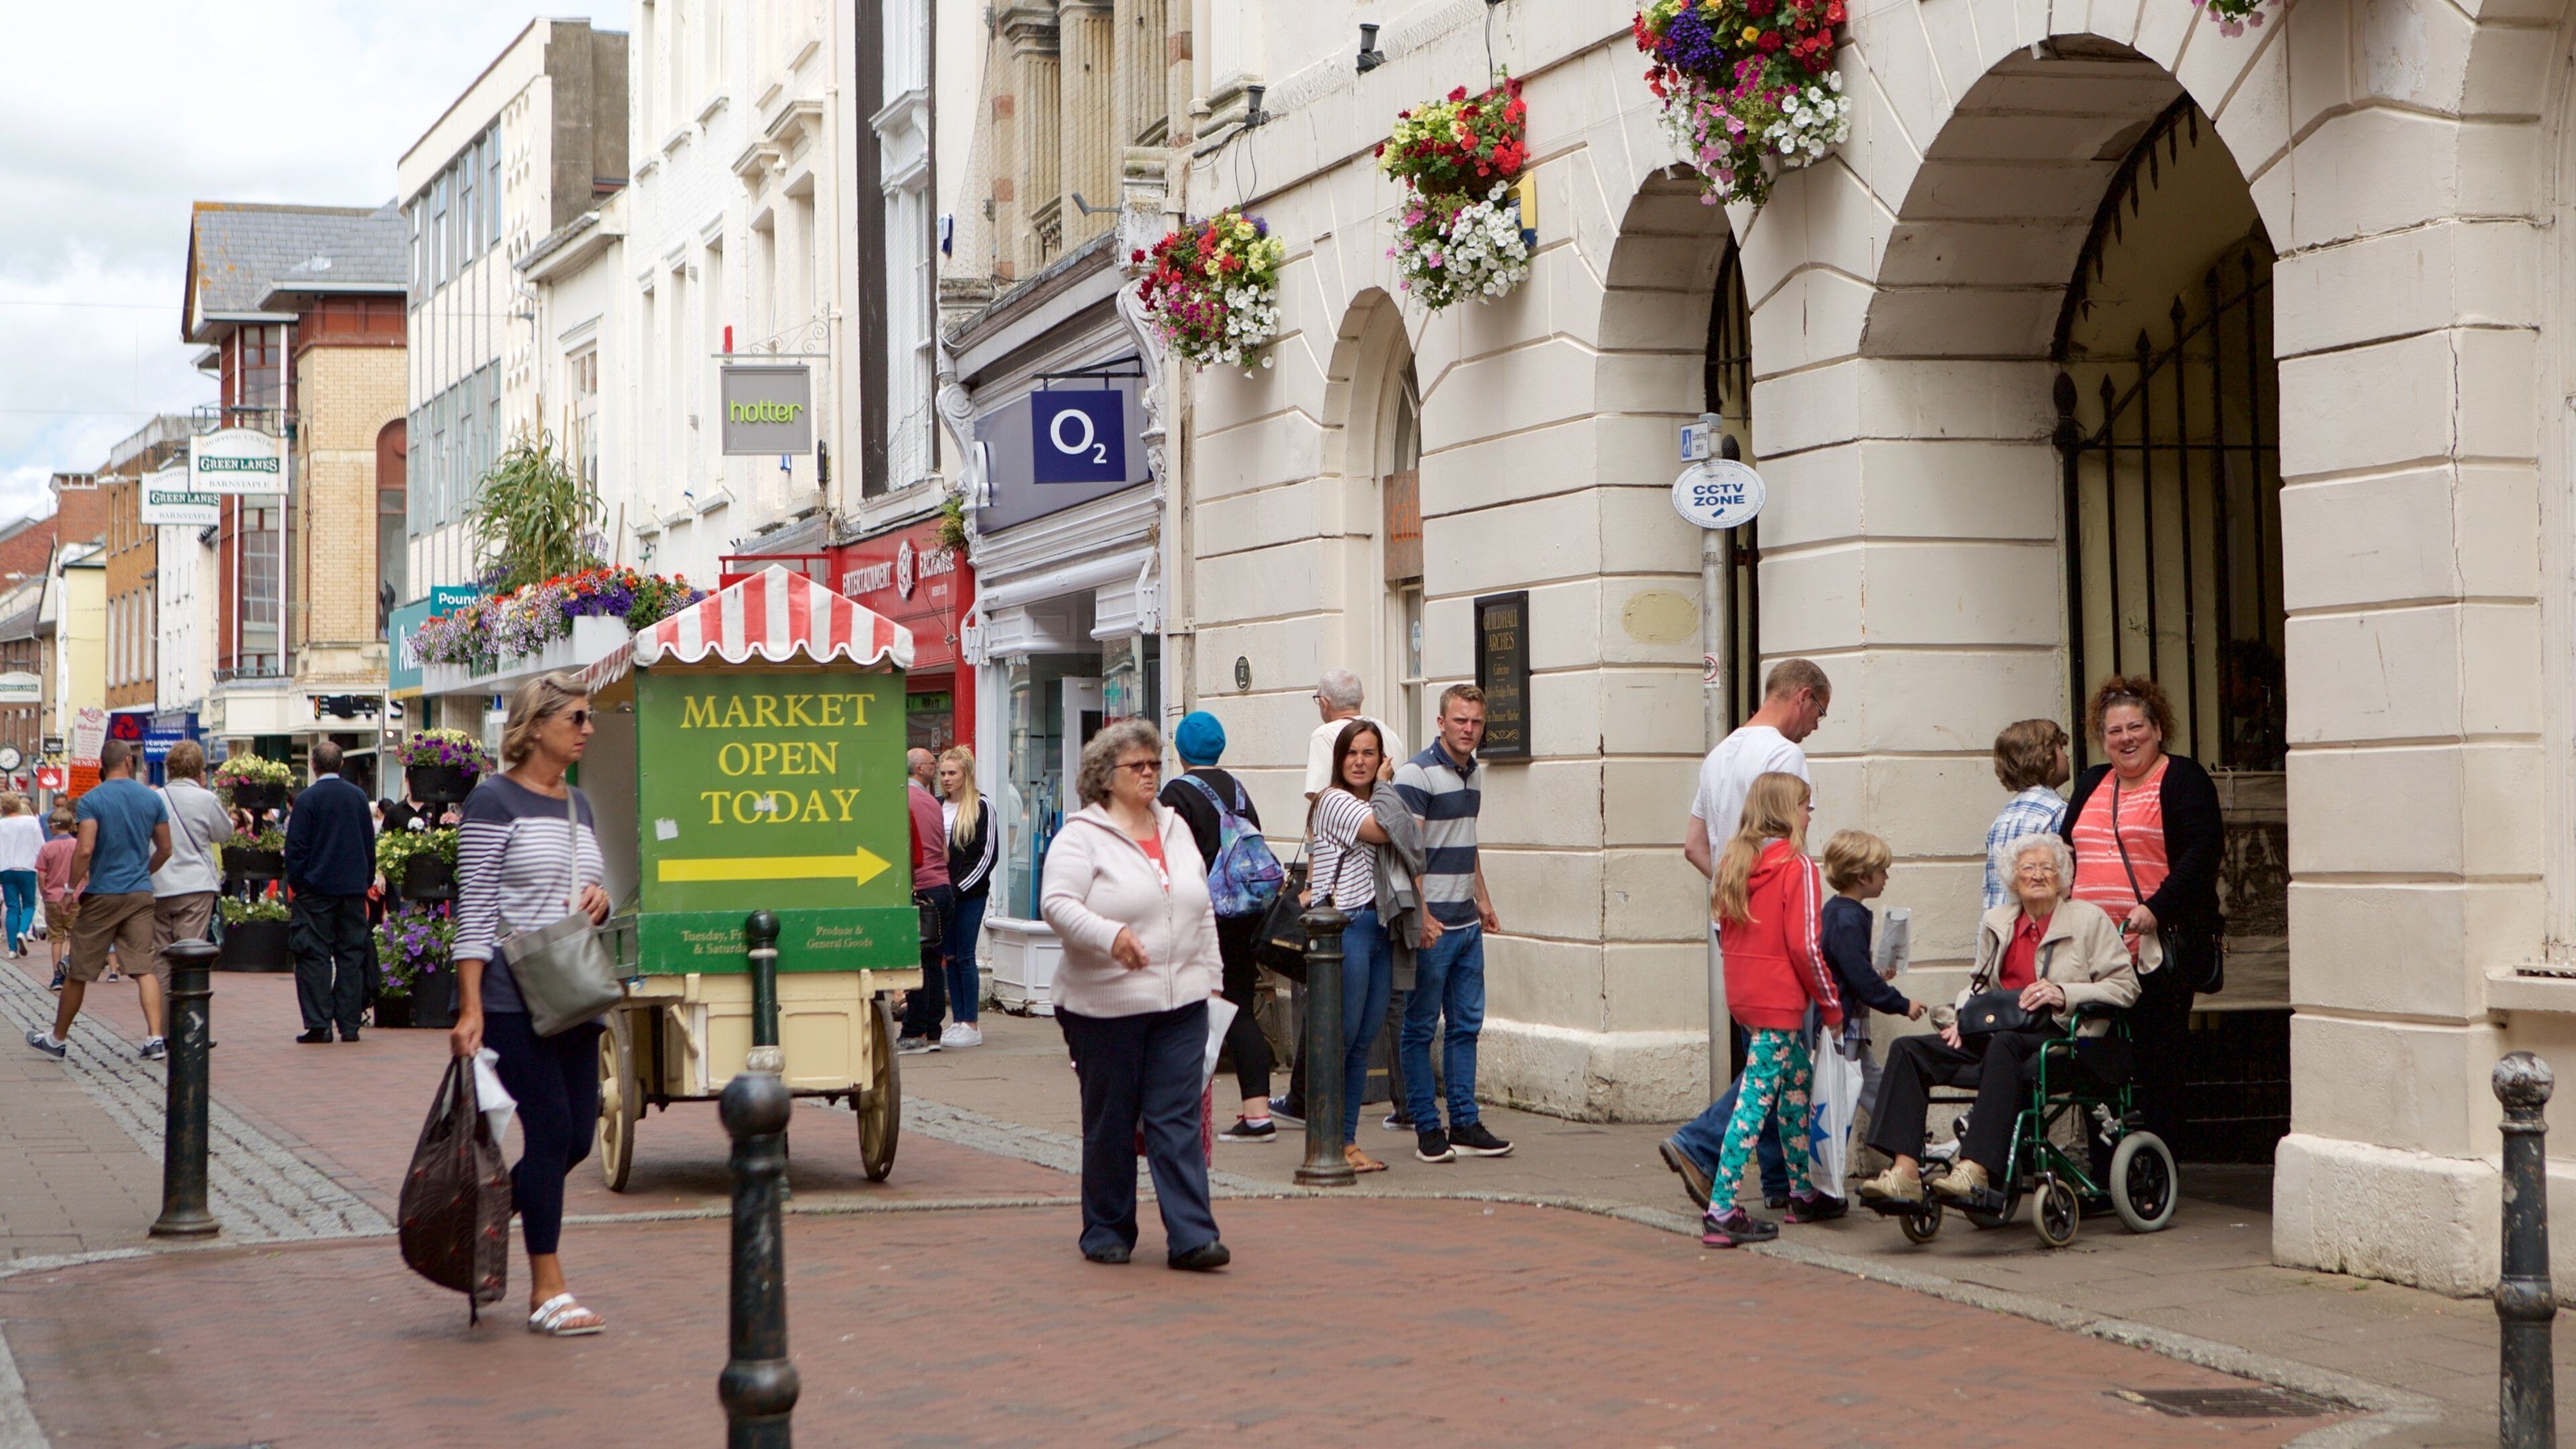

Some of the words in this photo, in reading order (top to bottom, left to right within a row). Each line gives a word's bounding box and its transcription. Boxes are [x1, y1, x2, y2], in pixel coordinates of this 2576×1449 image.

[730, 400, 803, 423] hotter
[200, 458, 239, 471] GREEN
[240, 458, 278, 472] LANES
[209, 479, 269, 488] BARNSTAPLE
[1693, 483, 1744, 495] CCTV
[151, 491, 186, 504] GREEN
[1694, 494, 1746, 506] ZONE
[160, 513, 213, 521] BARNSTAPLE
[843, 561, 892, 598] ENTERTAINMENT
[1483, 608, 1519, 631] GUILDHALL
[1487, 632, 1515, 651] ARCHES
[680, 694, 875, 729] MARKET
[718, 742, 839, 776] OPEN
[700, 789, 861, 824] TODAY
[680, 929, 728, 943] Tuesday,
[816, 926, 853, 936] Produce
[855, 925, 864, 935] &
[693, 943, 703, 955] &
[706, 942, 749, 955] Saturda
[806, 938, 842, 949] General
[843, 937, 873, 948] Goods
